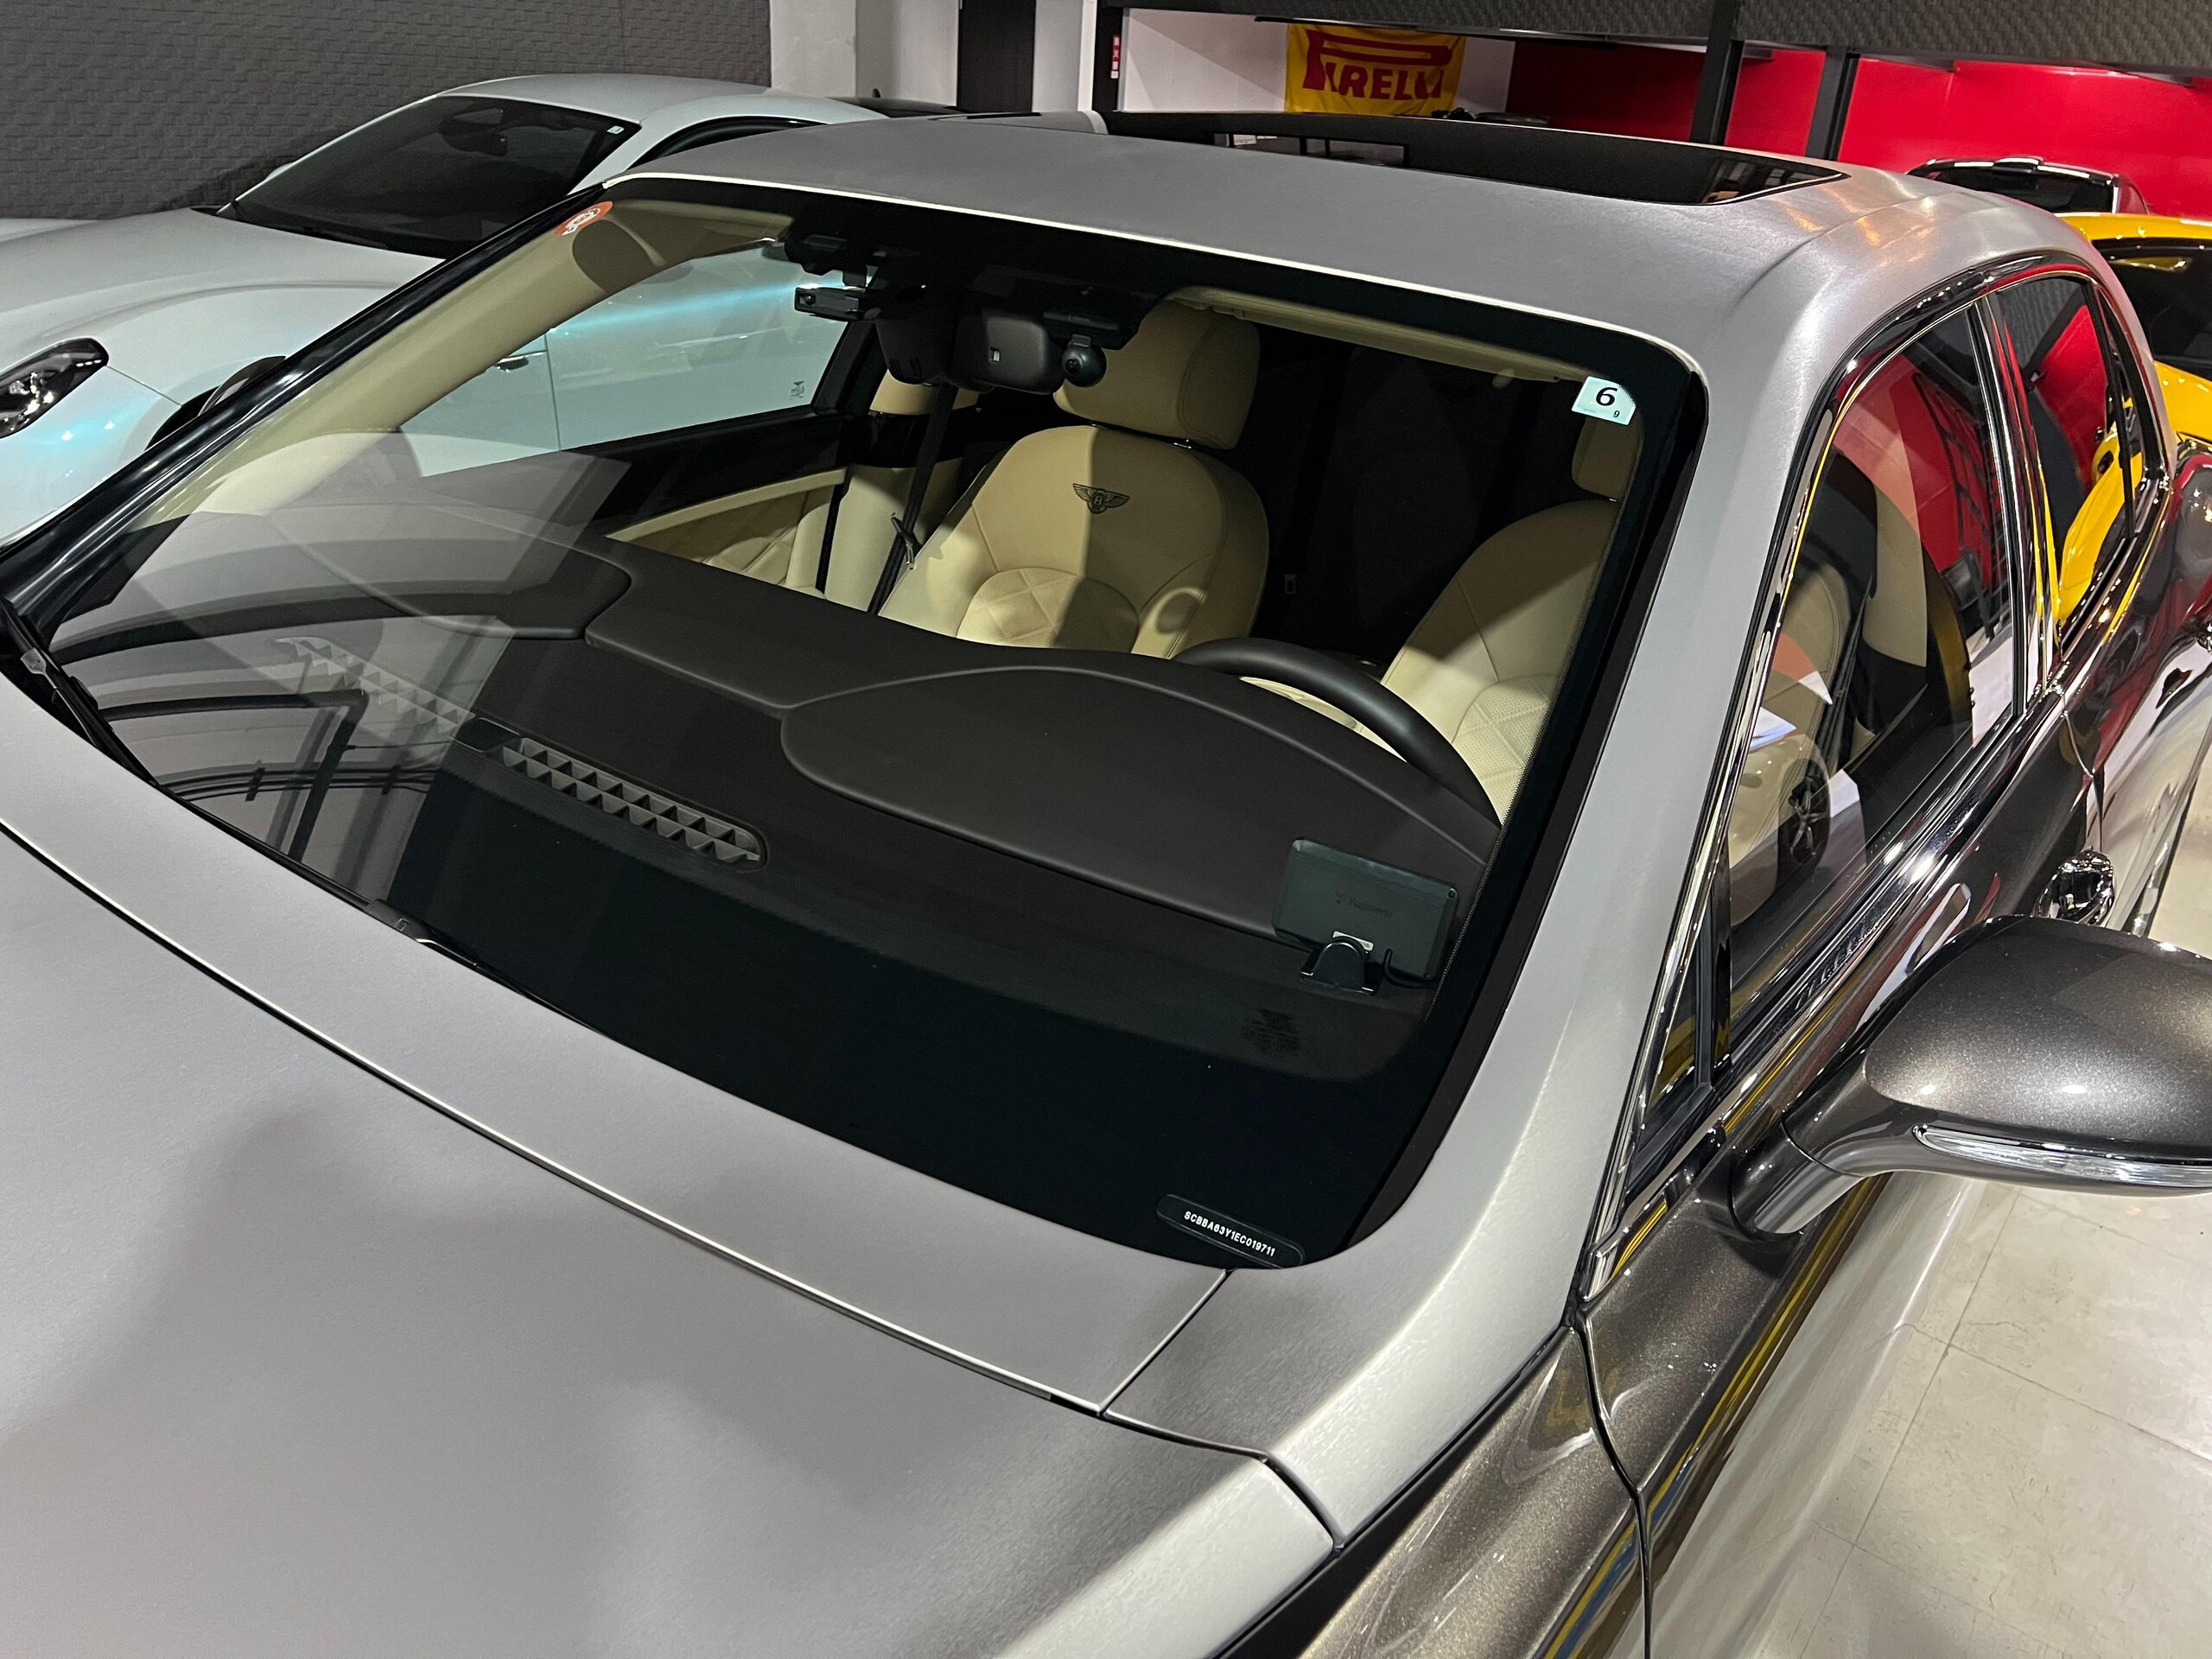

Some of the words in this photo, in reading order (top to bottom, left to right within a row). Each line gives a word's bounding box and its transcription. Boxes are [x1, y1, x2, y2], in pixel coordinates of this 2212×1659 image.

[1302, 29, 1453, 101] PIRELLI
[1595, 386, 1618, 407] 6
[1612, 410, 1621, 418] 9
[1184, 1211, 1276, 1257] SCBBA63Y1EC019711
